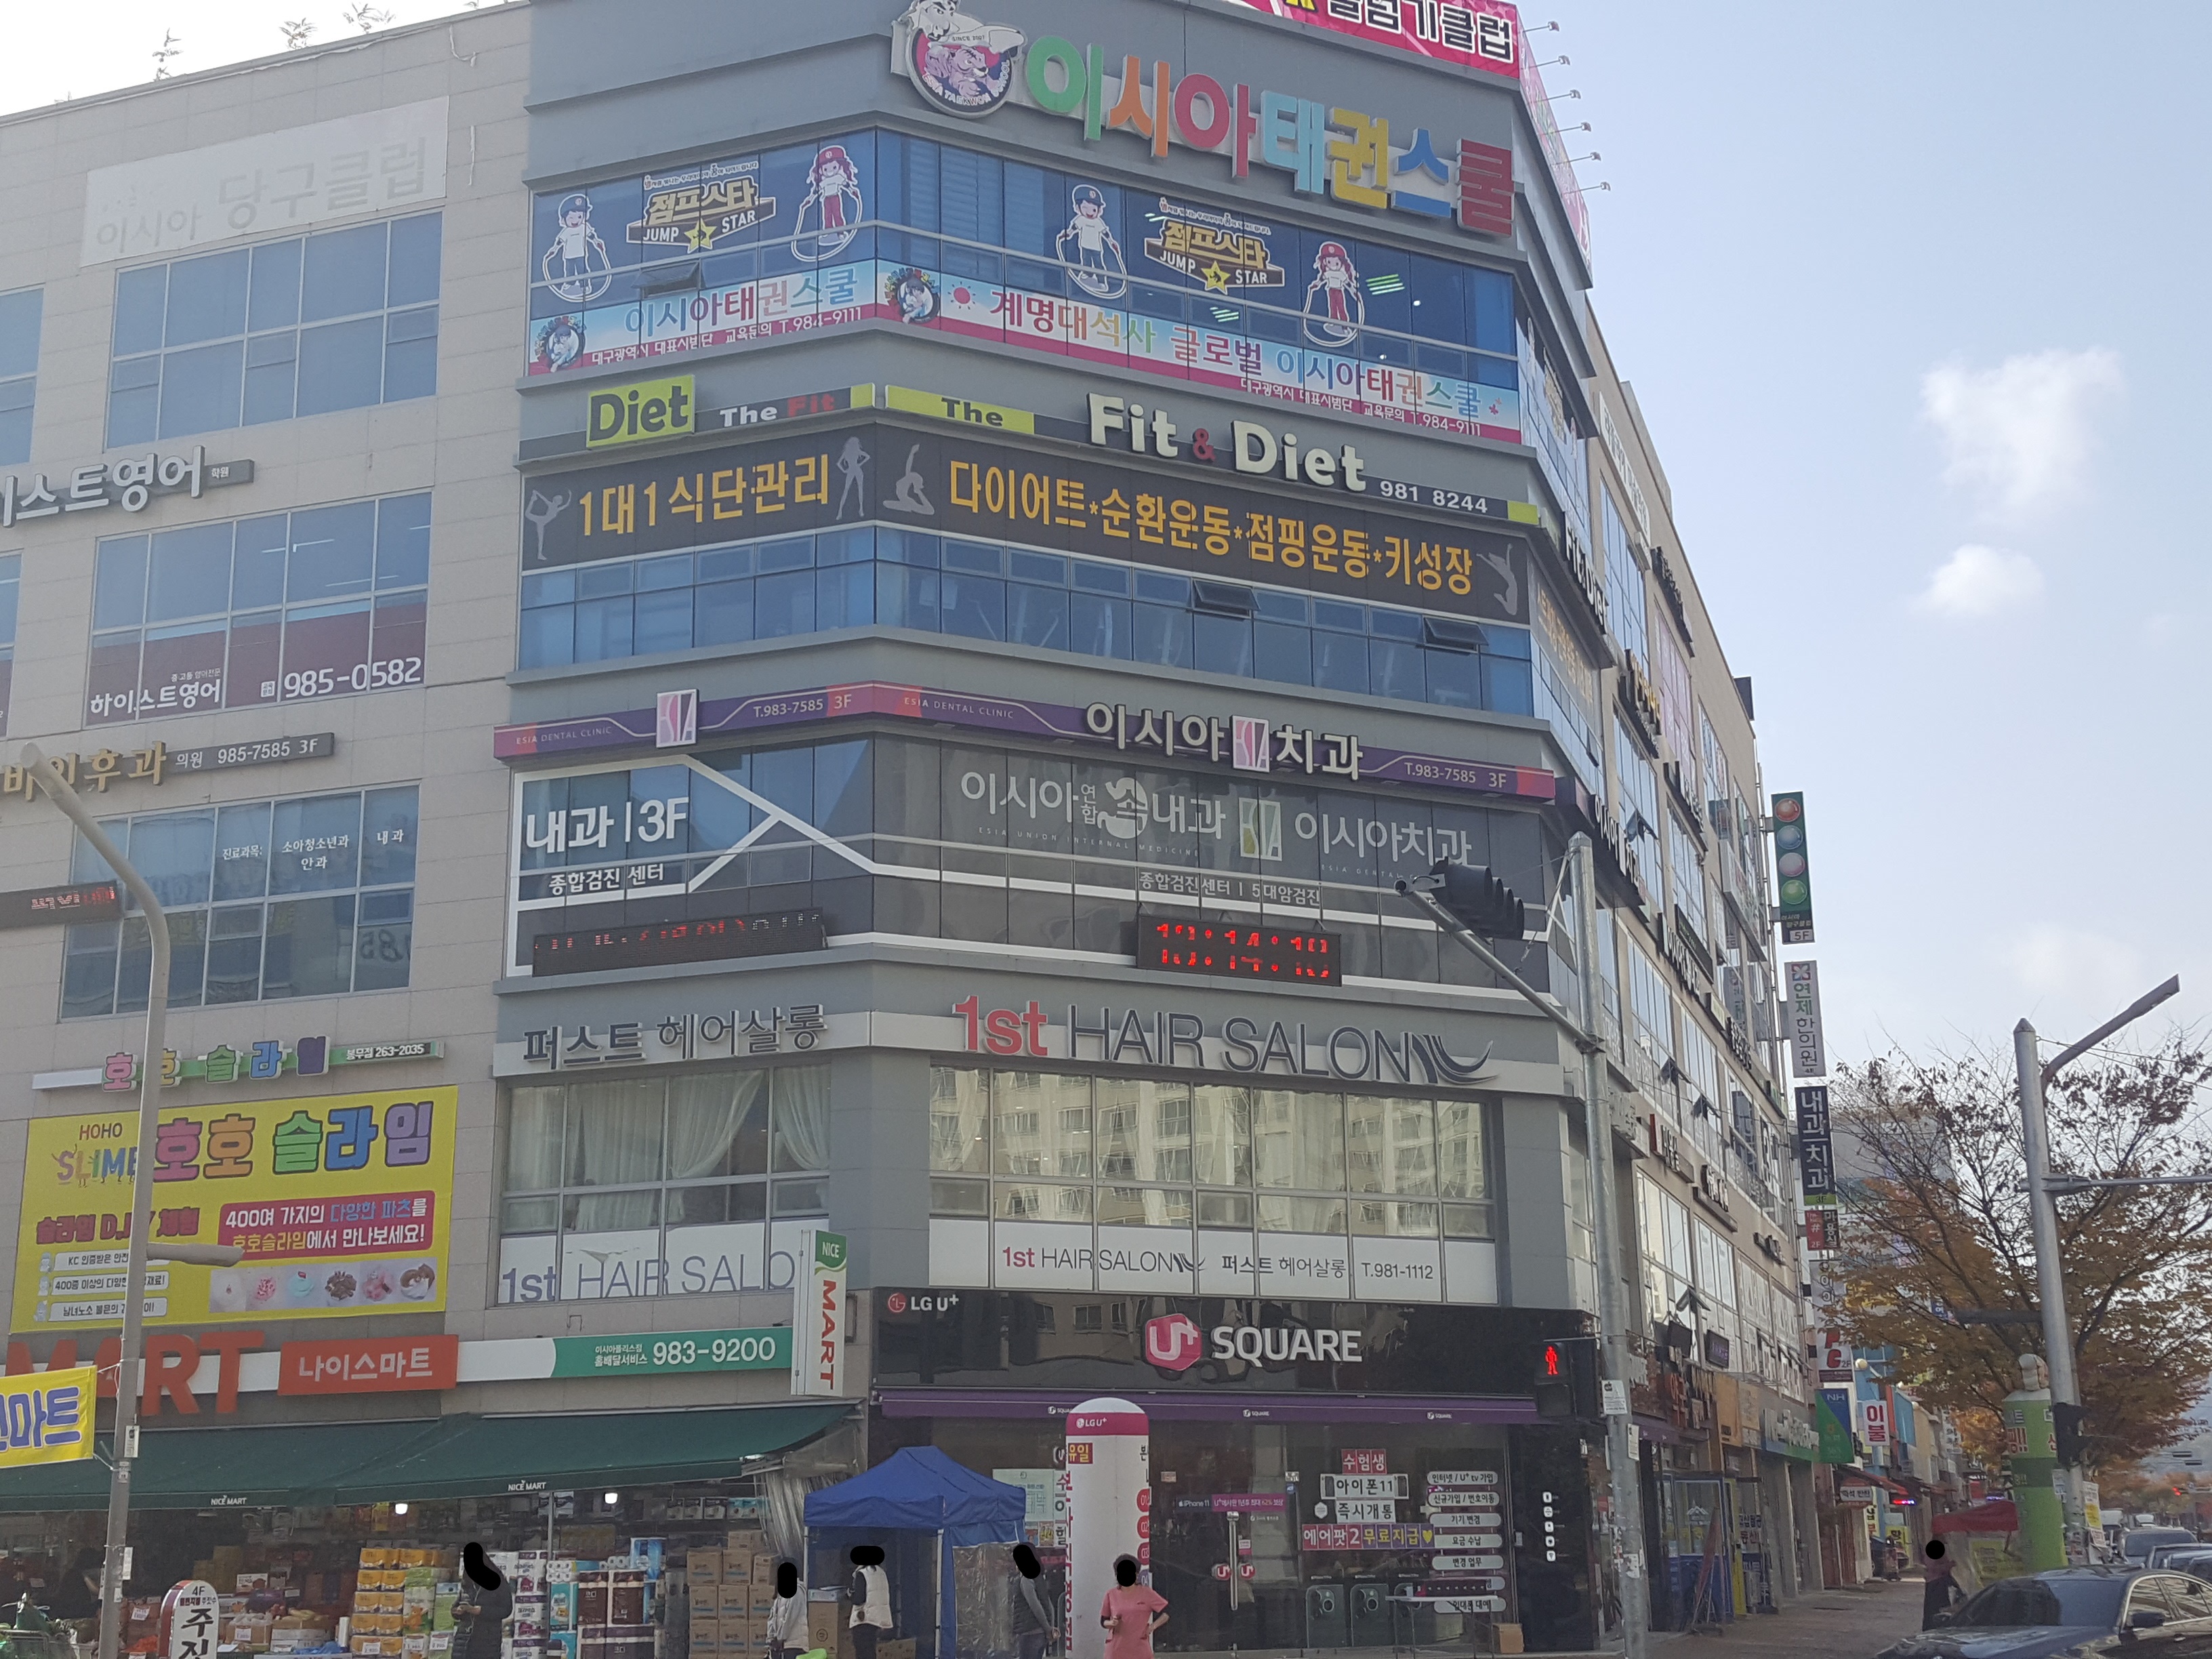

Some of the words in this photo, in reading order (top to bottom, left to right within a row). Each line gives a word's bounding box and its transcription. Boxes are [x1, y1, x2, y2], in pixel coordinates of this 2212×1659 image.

[945, 89, 991, 106] TAEKWON
[1026, 35, 1514, 237] 이시아태권스쿨
[96, 205, 201, 253] 이시아
[220, 138, 426, 230] 당구클럽
[648, 179, 755, 226] 점프스타
[643, 227, 679, 242] JUMP
[722, 210, 756, 232] STAR
[1164, 221, 1266, 268] 점프스타
[1160, 251, 1196, 273] JUMP
[1235, 269, 1267, 284] STAR
[625, 268, 858, 337] 이시아태권스쿨
[592, 344, 649, 365] 대구광역시
[725, 323, 772, 344] 교육문의
[989, 289, 1156, 353] 계명대석사
[1170, 325, 1263, 377] 글로벌
[1277, 348, 1481, 417] 이시아태권스쿨
[590, 385, 689, 441] Diet
[720, 407, 778, 428] The
[787, 394, 835, 417] Fit
[1241, 378, 1294, 401] 대구광역시
[1300, 390, 1353, 413] 대표시범단
[1364, 401, 1405, 424] 교육문의
[941, 397, 1004, 426] The
[1088, 392, 1180, 457] Fit
[1191, 428, 1215, 463] &
[1232, 419, 1367, 493] Diet
[0, 445, 205, 527] 스트영어
[211, 466, 230, 478] 학원
[1379, 480, 1420, 503] 981
[1432, 487, 1488, 514] 8244
[949, 458, 1087, 529] 다이어트
[1101, 487, 1230, 556] 순환운동
[1244, 512, 1370, 577] 점핑운동
[1383, 541, 1473, 596] 키성장
[284, 657, 422, 699] 985-0582
[90, 679, 221, 716] 하이스트영어
[754, 699, 823, 718] T.983-7585
[834, 694, 853, 710] 3F
[904, 697, 928, 707] ESIA
[934, 701, 974, 715] DENTAL
[979, 708, 1014, 719] CLINIC
[516, 735, 537, 744] ESIA
[541, 732, 577, 743] DENTAL
[581, 726, 613, 737] CLINIC
[1086, 702, 1225, 762] 이시아
[176, 751, 203, 768] 의원
[218, 743, 291, 764] 985-7585
[299, 739, 318, 754] 3F
[1275, 724, 1364, 781] 치과
[1404, 762, 1477, 784] T.983-7585
[1488, 773, 1507, 789] 3F
[638, 797, 689, 842] 3F
[961, 771, 1080, 823] 이시아
[1152, 793, 1226, 840] 내과
[282, 835, 350, 854] 소아청소년과
[377, 829, 405, 844] 내과
[526, 806, 614, 854] 내과
[979, 827, 1007, 836] ESIA
[1017, 831, 1059, 842] UNION
[1067, 836, 1130, 850] INTERNAL
[1139, 844, 1200, 857] MEDICINE
[1294, 812, 1473, 865] 이시아치과
[302, 856, 328, 870] 안과
[549, 867, 621, 896] 종합검진
[628, 863, 664, 886] 센터
[1252, 883, 1322, 907] 5대암검진
[1795, 930, 1809, 941] 5F
[347, 1046, 372, 1061] 봉무점
[374, 1044, 424, 1057] 263-2035
[524, 1022, 648, 1071] 퍼스트
[657, 1004, 828, 1061] 헤어살롱
[952, 994, 1048, 1057] 1st
[1068, 1004, 1206, 1068] HAIR
[1221, 1015, 1414, 1084] SALON
[1801, 1091, 1824, 1136] 내과
[79, 1122, 123, 1141] HOHO
[153, 1113, 255, 1182] 호호
[272, 1101, 434, 1174] 슬라임
[226, 1208, 274, 1229] 400여
[280, 1206, 325, 1225] 가지의
[330, 1202, 376, 1223] 다양한
[381, 1197, 428, 1220] 파츠를
[232, 1229, 337, 1252] 호호슬라임에서
[342, 1223, 425, 1248] 만나보세요!
[821, 1242, 841, 1259] NICE
[68, 1256, 79, 1265] KC
[503, 1265, 556, 1303] 1st
[579, 1257, 670, 1299] HAIR
[682, 1250, 796, 1294] SALO
[1002, 1245, 1035, 1270] 1st
[1040, 1247, 1092, 1271] HAIR
[1099, 1248, 1173, 1273] SALON
[1221, 1254, 1273, 1277] 퍼스트
[1278, 1256, 1347, 1280] 헤어살롱
[1361, 1260, 1433, 1282] T.981-1112
[81, 1278, 104, 1289] 이상의
[911, 1296, 933, 1311] LG
[595, 1343, 642, 1354] 이시아폴리스점
[820, 1279, 838, 1390] MART
[1212, 1326, 1363, 1368] SQUARE
[299, 1347, 433, 1382] 나이스마트
[595, 1353, 648, 1367] 홈배달서비스
[653, 1337, 776, 1366] 983-9200
[0, 1385, 81, 1452] 마트
[1085, 1419, 1095, 1427] LG
[1866, 1405, 1886, 1443] 이불
[1069, 1443, 1090, 1463] 유일
[1343, 1454, 1385, 1471] 수험생
[508, 1482, 525, 1491] NICE
[526, 1481, 546, 1490] MART
[1336, 1479, 1393, 1495] 아이폰11
[1432, 1473, 1452, 1483] 인터넷
[1481, 1473, 1494, 1483] 가입
[211, 1496, 226, 1505] NICE
[227, 1497, 247, 1505] MART
[1338, 1502, 1393, 1519] 즉시개통
[1434, 1494, 1460, 1504] 신규가입
[1468, 1494, 1495, 1504] 번호이동
[1452, 1515, 1465, 1525] 기기
[1467, 1515, 1480, 1525] 변경
[1452, 1536, 1465, 1546] 요금
[1468, 1536, 1481, 1546] 수납
[1452, 1558, 1466, 1568] 변경
[1468, 1557, 1482, 1568] 업무
[192, 1586, 205, 1596] 4F
